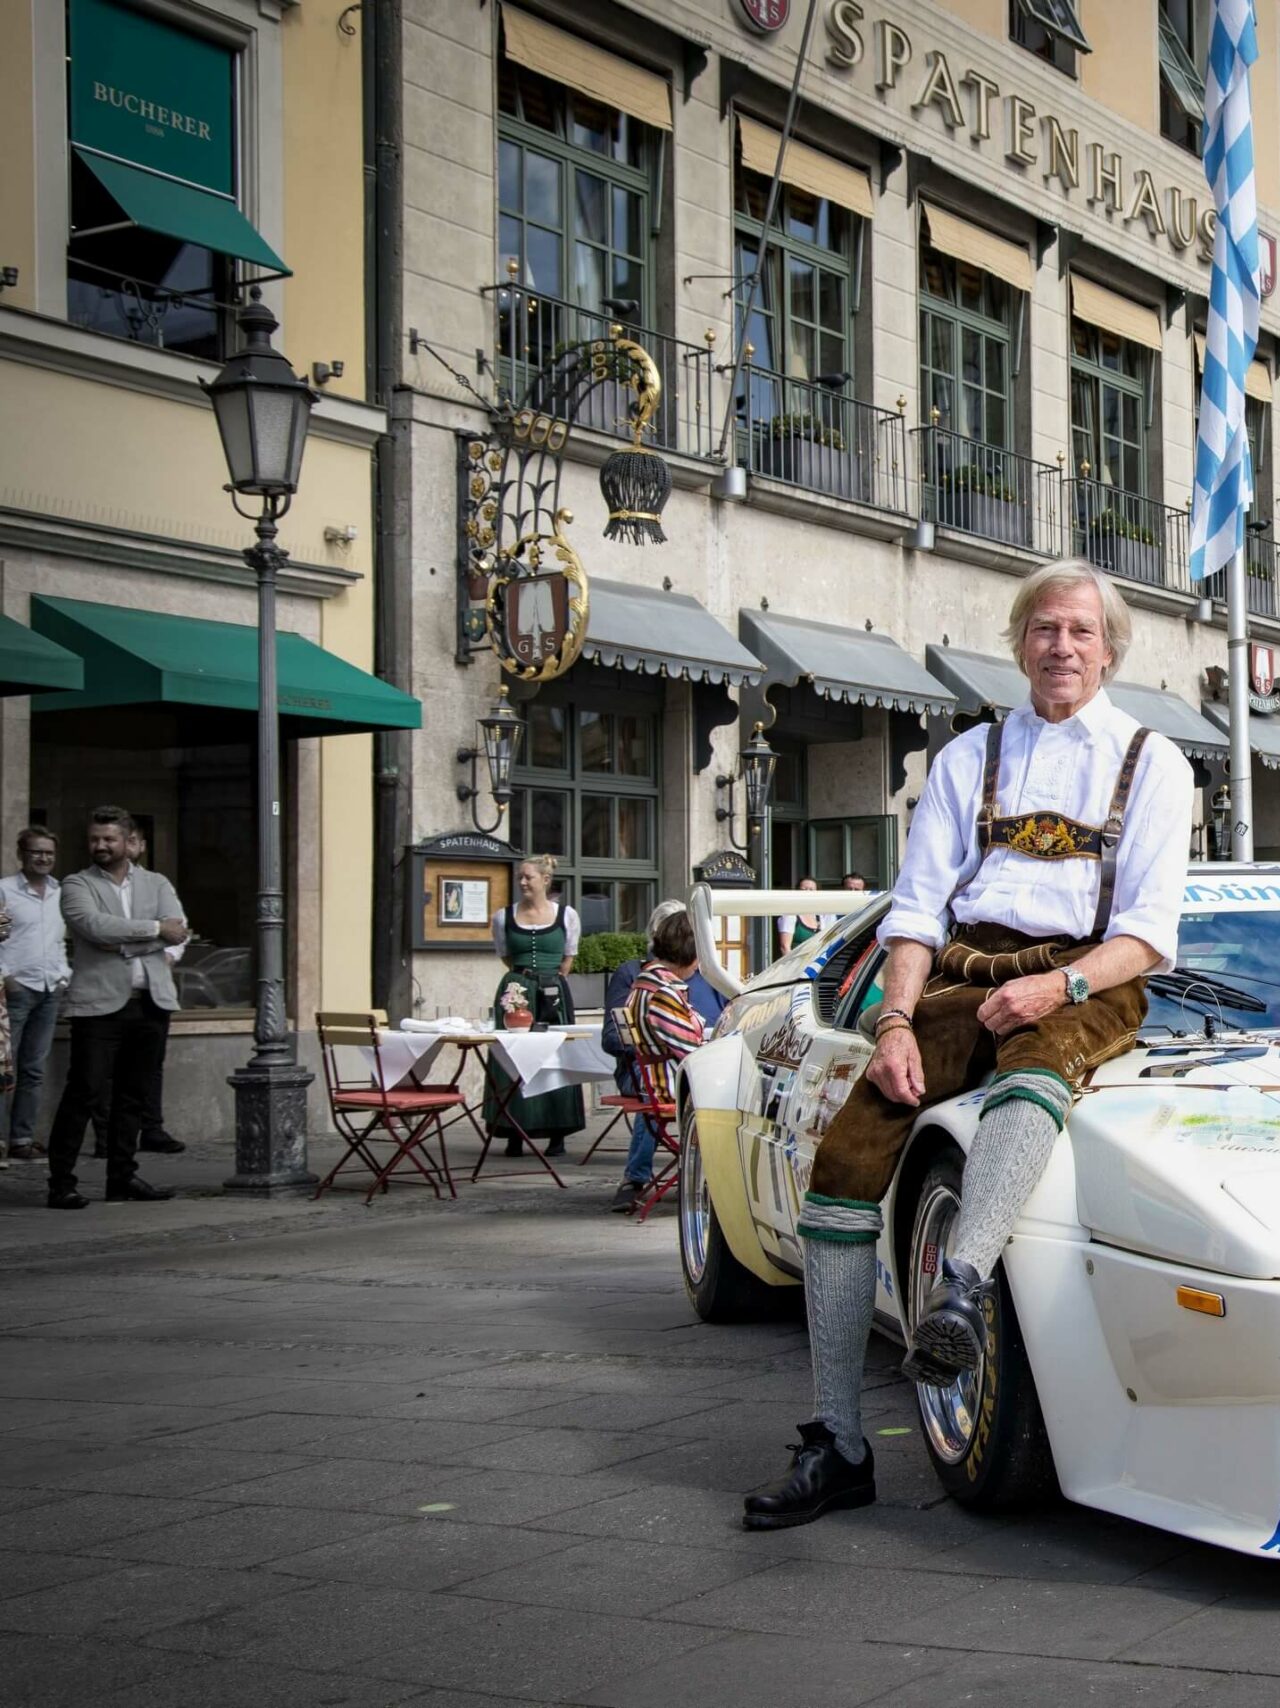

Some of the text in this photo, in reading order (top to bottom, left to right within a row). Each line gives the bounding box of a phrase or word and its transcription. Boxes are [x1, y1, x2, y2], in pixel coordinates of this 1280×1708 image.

[93, 81, 212, 141] BUCHERER
[825, 0, 1223, 263] SPATENHAUS
[518, 637, 555, 653] G S
[440, 837, 500, 852] SPATENHAUS
[925, 1243, 937, 1274] BBS
